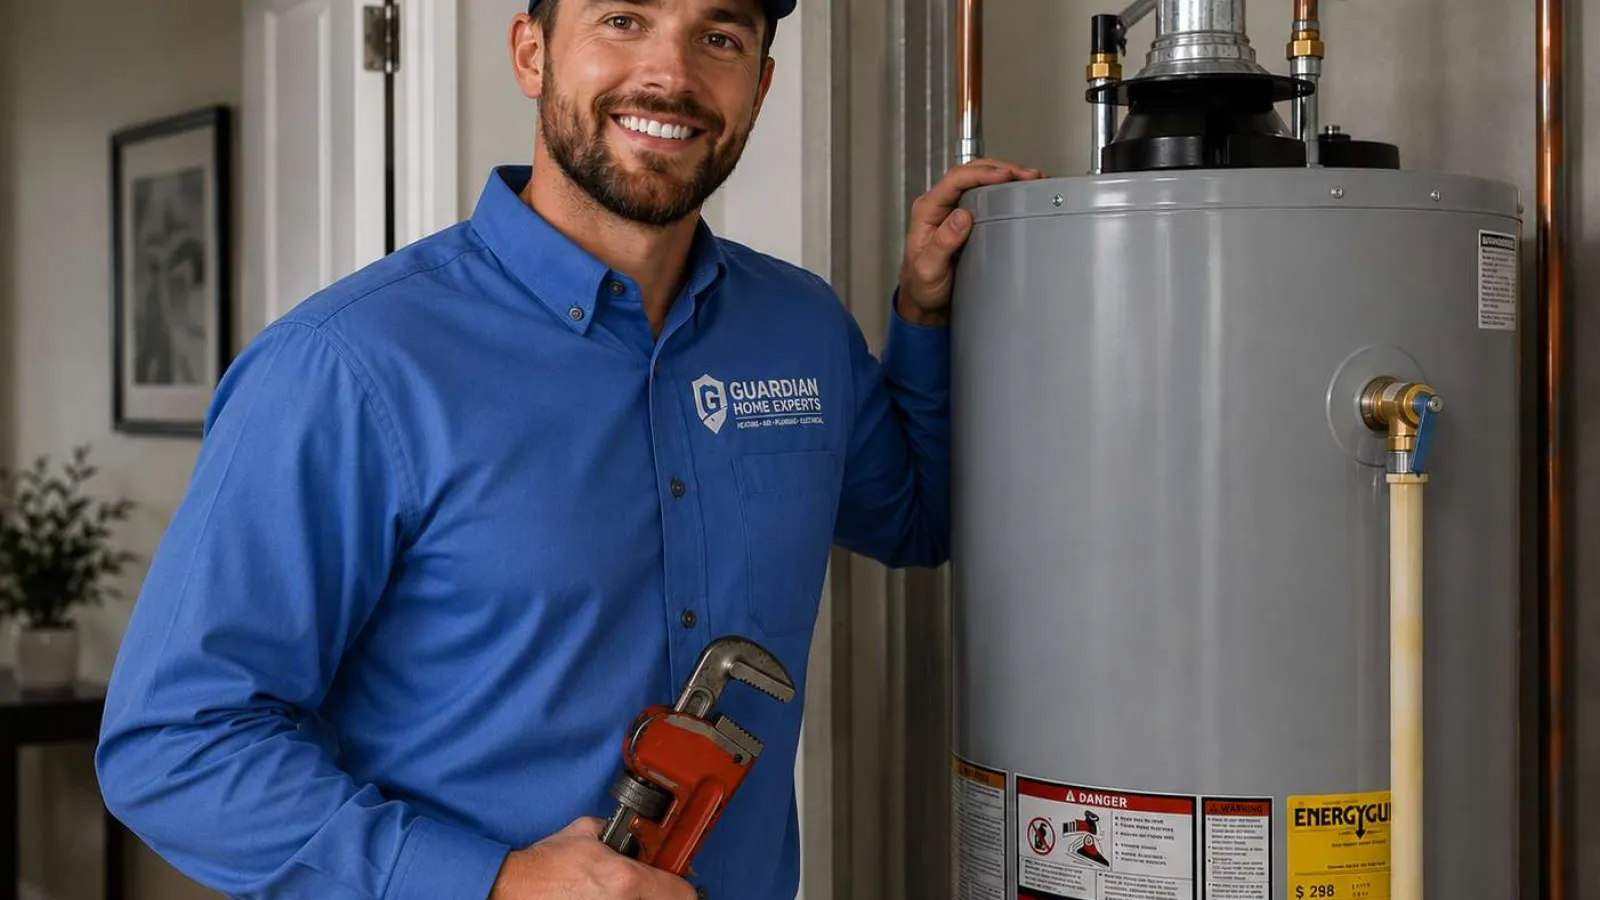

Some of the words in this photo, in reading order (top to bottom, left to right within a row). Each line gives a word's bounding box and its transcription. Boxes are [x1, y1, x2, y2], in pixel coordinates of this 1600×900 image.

[729, 378, 819, 400] GUARDIAN
[701, 386, 720, 410] G
[733, 400, 770, 415] HOME
[773, 398, 821, 412] EXPERTS
[1079, 793, 1128, 809] DANGER
[1221, 803, 1264, 813] WARNING
[1296, 884, 1304, 899] $
[1310, 884, 1335, 898] 298
